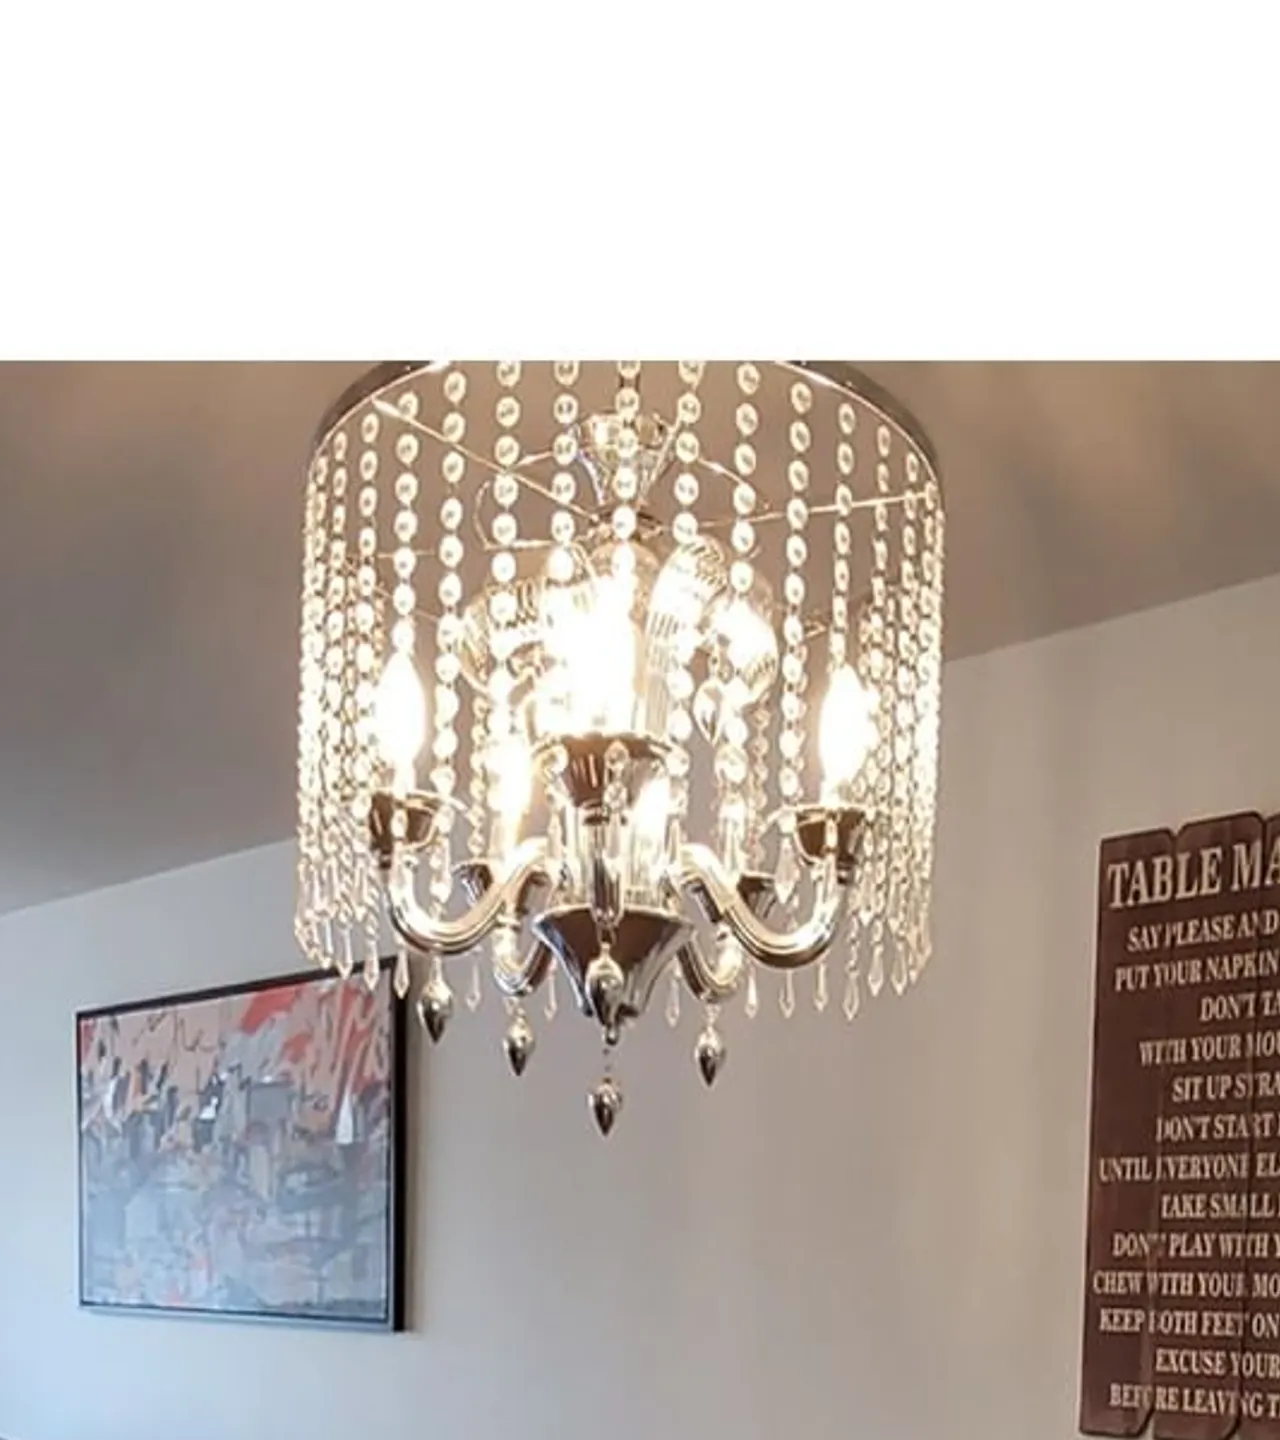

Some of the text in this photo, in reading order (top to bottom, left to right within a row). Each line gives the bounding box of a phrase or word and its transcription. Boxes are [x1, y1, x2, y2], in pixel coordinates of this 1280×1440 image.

[1107, 846, 1222, 908] TABLE
[1127, 922, 1160, 952] SAY
[1164, 915, 1234, 948] PLEASE
[1115, 964, 1149, 992] PUT
[1152, 959, 1203, 988] YOUR
[1205, 950, 1279, 983] NAPKIN
[1199, 992, 1257, 1022] DON'T
[1139, 1039, 1187, 1067] WITH
[1190, 1033, 1242, 1062] YOUR
[1172, 1076, 1204, 1103] SIT
[1206, 1073, 1233, 1100] UP
[1212, 1112, 1274, 1140] START
[1099, 1157, 1152, 1183] UNTIL
[1161, 1194, 1206, 1219] TAKE
[1209, 1193, 1274, 1219] SMALL
[1170, 1233, 1217, 1258] PLAY
[1219, 1233, 1269, 1258] WITH
[1093, 1271, 1144, 1295] CHEW
[1146, 1272, 1194, 1296] WITH
[1099, 1308, 1145, 1333] KEEP
[1200, 1310, 1251, 1337] FEET
[1252, 1313, 1280, 1338] ON
[1155, 1349, 1227, 1375] EXCUSE
[1109, 1383, 1179, 1410] BEFORE
